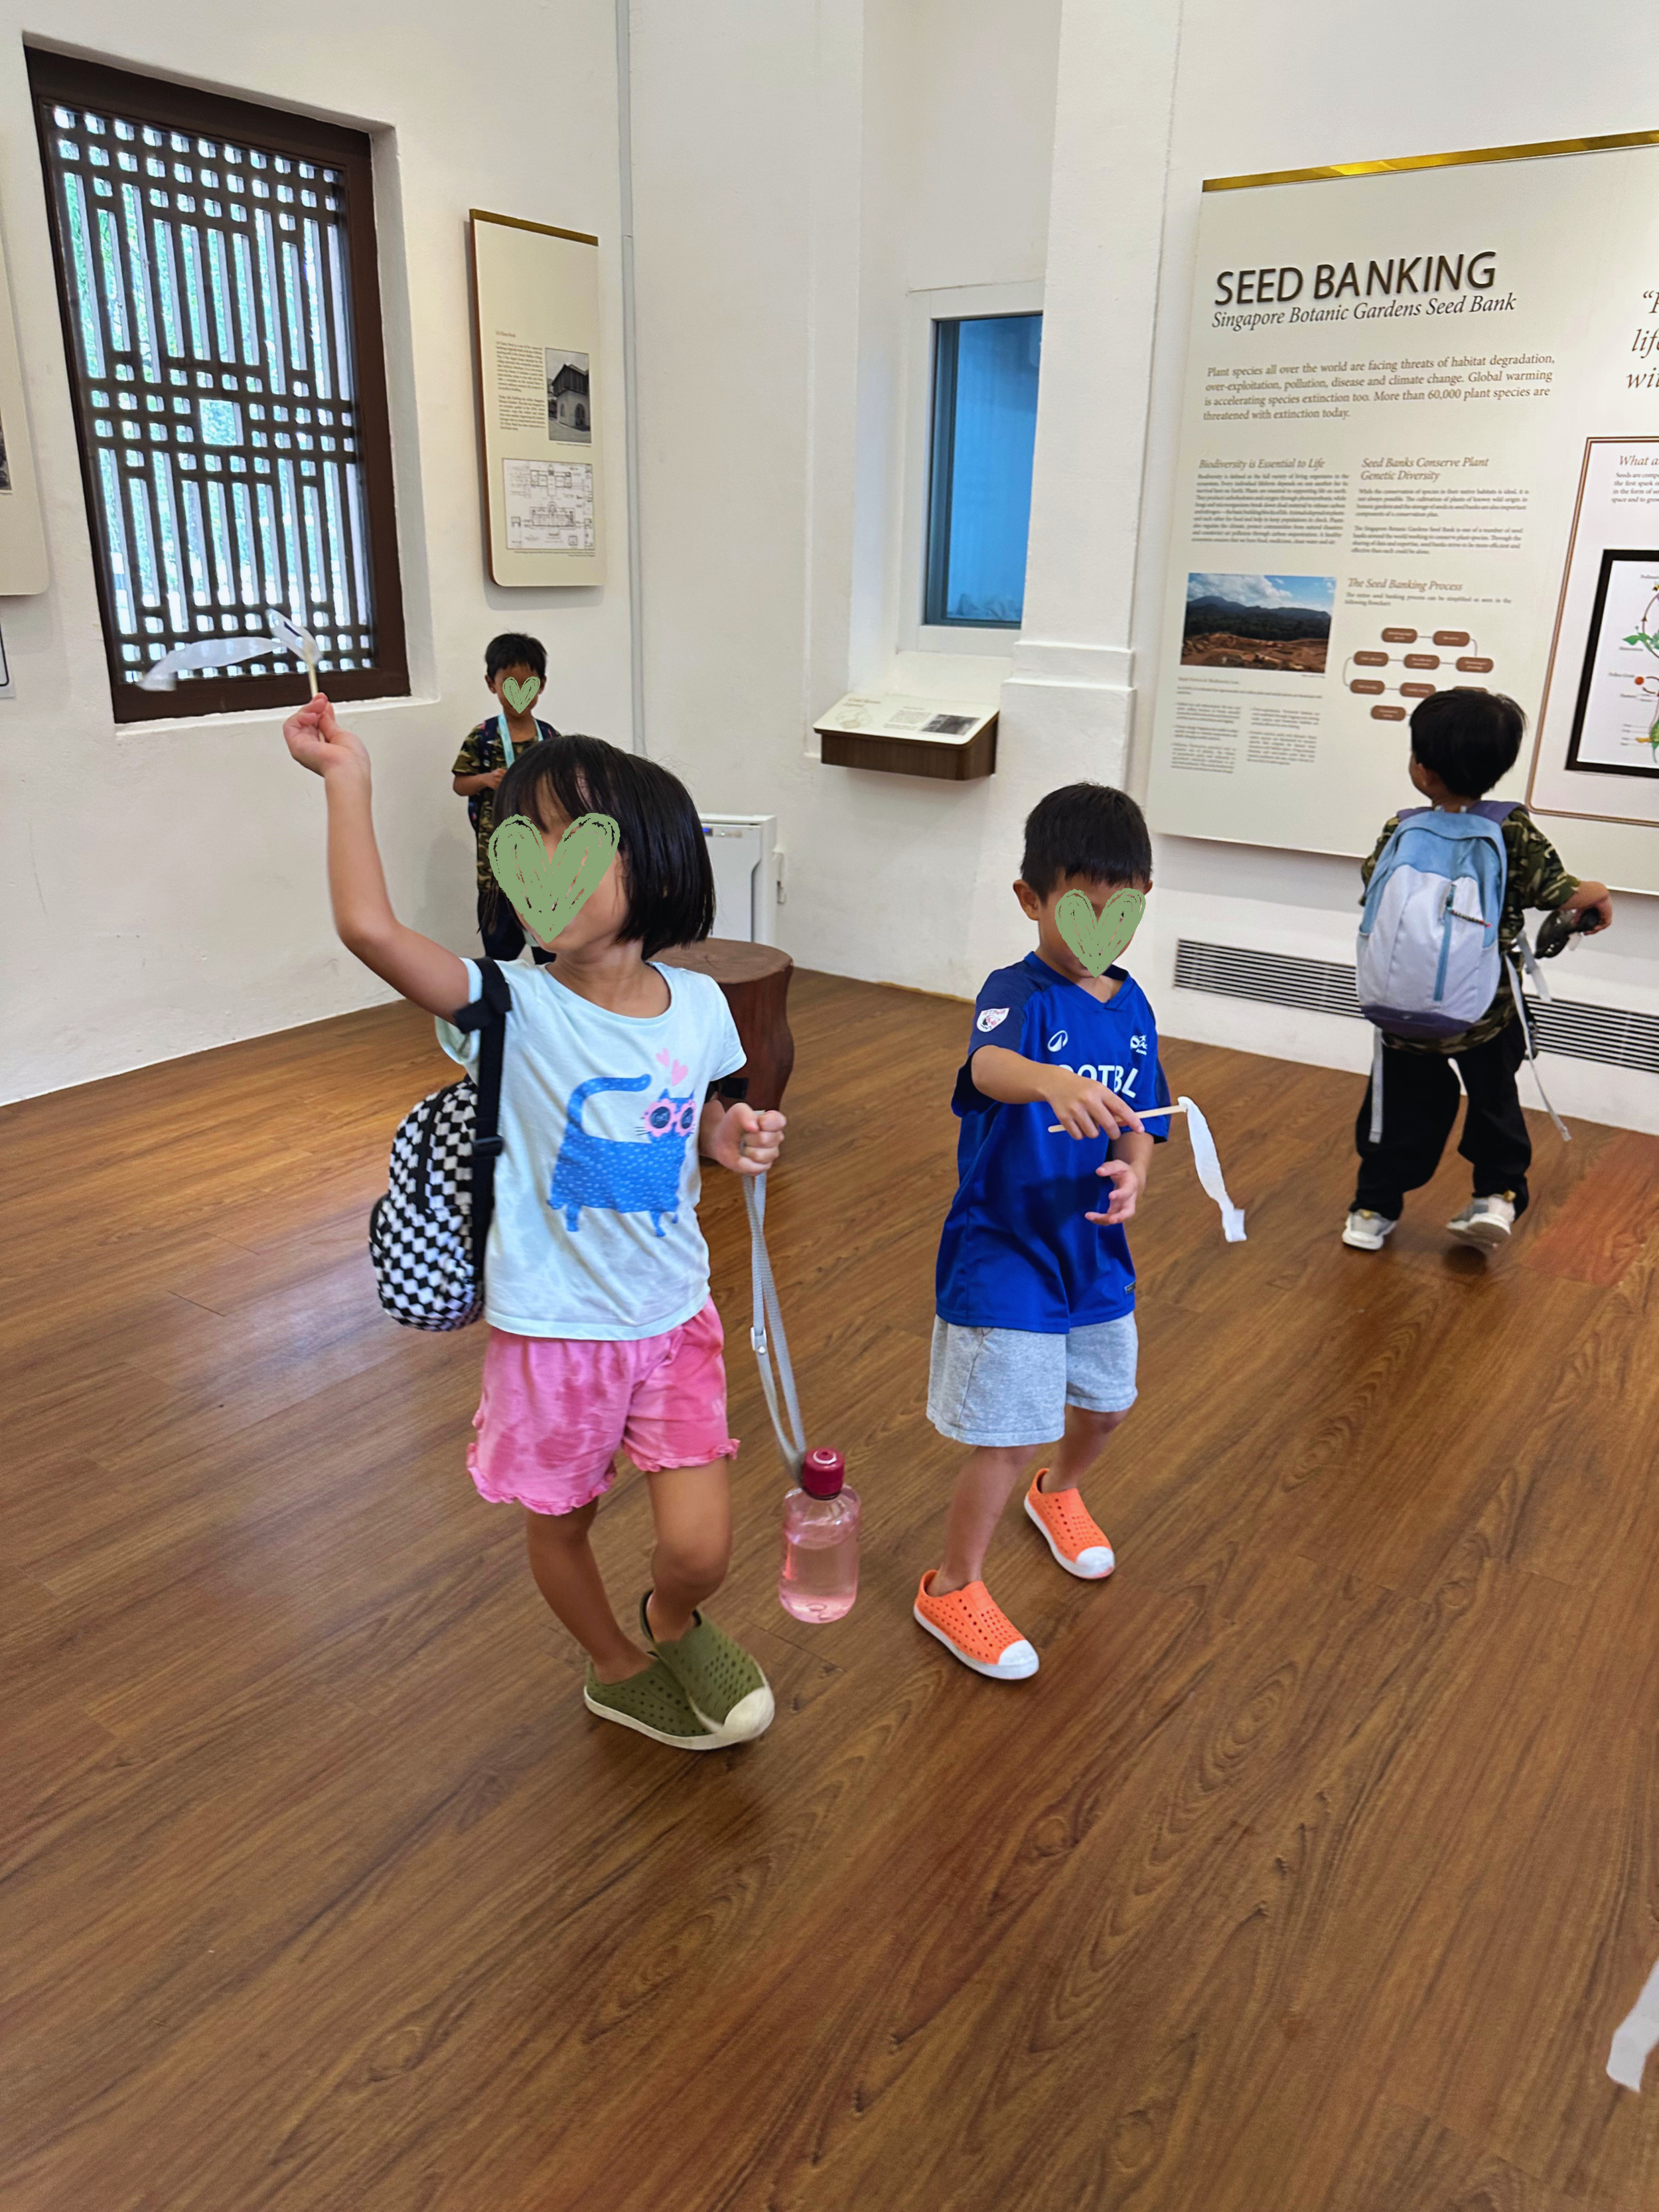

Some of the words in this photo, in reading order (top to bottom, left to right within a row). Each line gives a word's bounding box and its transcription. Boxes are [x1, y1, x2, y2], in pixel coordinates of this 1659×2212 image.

[1214, 267, 1304, 306] SEED
[1313, 251, 1496, 299] BANKING
[1212, 311, 1285, 332] Singapore
[1289, 305, 1350, 324] Botanic
[1353, 300, 1423, 319] Gardens
[1426, 295, 1467, 315] Seed
[1469, 292, 1517, 313] Bank
[1207, 367, 1229, 376] Plant
[1232, 366, 1263, 378] species
[1265, 364, 1277, 374] all
[1303, 363, 1317, 372] the
[1321, 362, 1348, 372] world
[1368, 360, 1398, 372] facing
[1401, 358, 1435, 369] threats
[1437, 356, 1450, 368] of
[1451, 356, 1486, 367] habitat
[1489, 354, 1555, 368] degradation,
[1331, 377, 1365, 387] disease
[1367, 375, 1386, 386] and
[1388, 374, 1425, 385] climate
[1427, 373, 1465, 386] change.
[1468, 370, 1503, 382] Global
[1506, 370, 1553, 383] warming
[1213, 395, 1266, 407] accelerating
[1268, 394, 1300, 407] species
[1302, 392, 1350, 404] extinction
[1373, 390, 1400, 401] More
[1402, 390, 1425, 400] than
[1427, 389, 1462, 400] 60,000
[1463, 388, 1491, 402] plant
[1493, 387, 1530, 400] species
[1533, 388, 1550, 397] are
[1203, 409, 1250, 421] threatened
[1252, 409, 1272, 419] with
[1273, 408, 1320, 419] extinction
[1198, 459, 1247, 471] Biodiversity
[1248, 459, 1256, 469] is
[1258, 458, 1296, 469] Essential
[1297, 460, 1307, 469] to
[1308, 457, 1325, 471] Life
[1361, 457, 1384, 468] Seed
[1385, 457, 1415, 467] Banks
[1416, 457, 1461, 467] Conserve
[1462, 456, 1490, 467] Plant
[1620, 455, 1649, 466] What
[1360, 470, 1396, 480] Genetic
[1397, 469, 1441, 482] Diversity
[1348, 577, 1365, 587] The
[1365, 577, 1388, 588] Seed
[1389, 579, 1427, 593] Banking
[1428, 580, 1463, 591] Process
